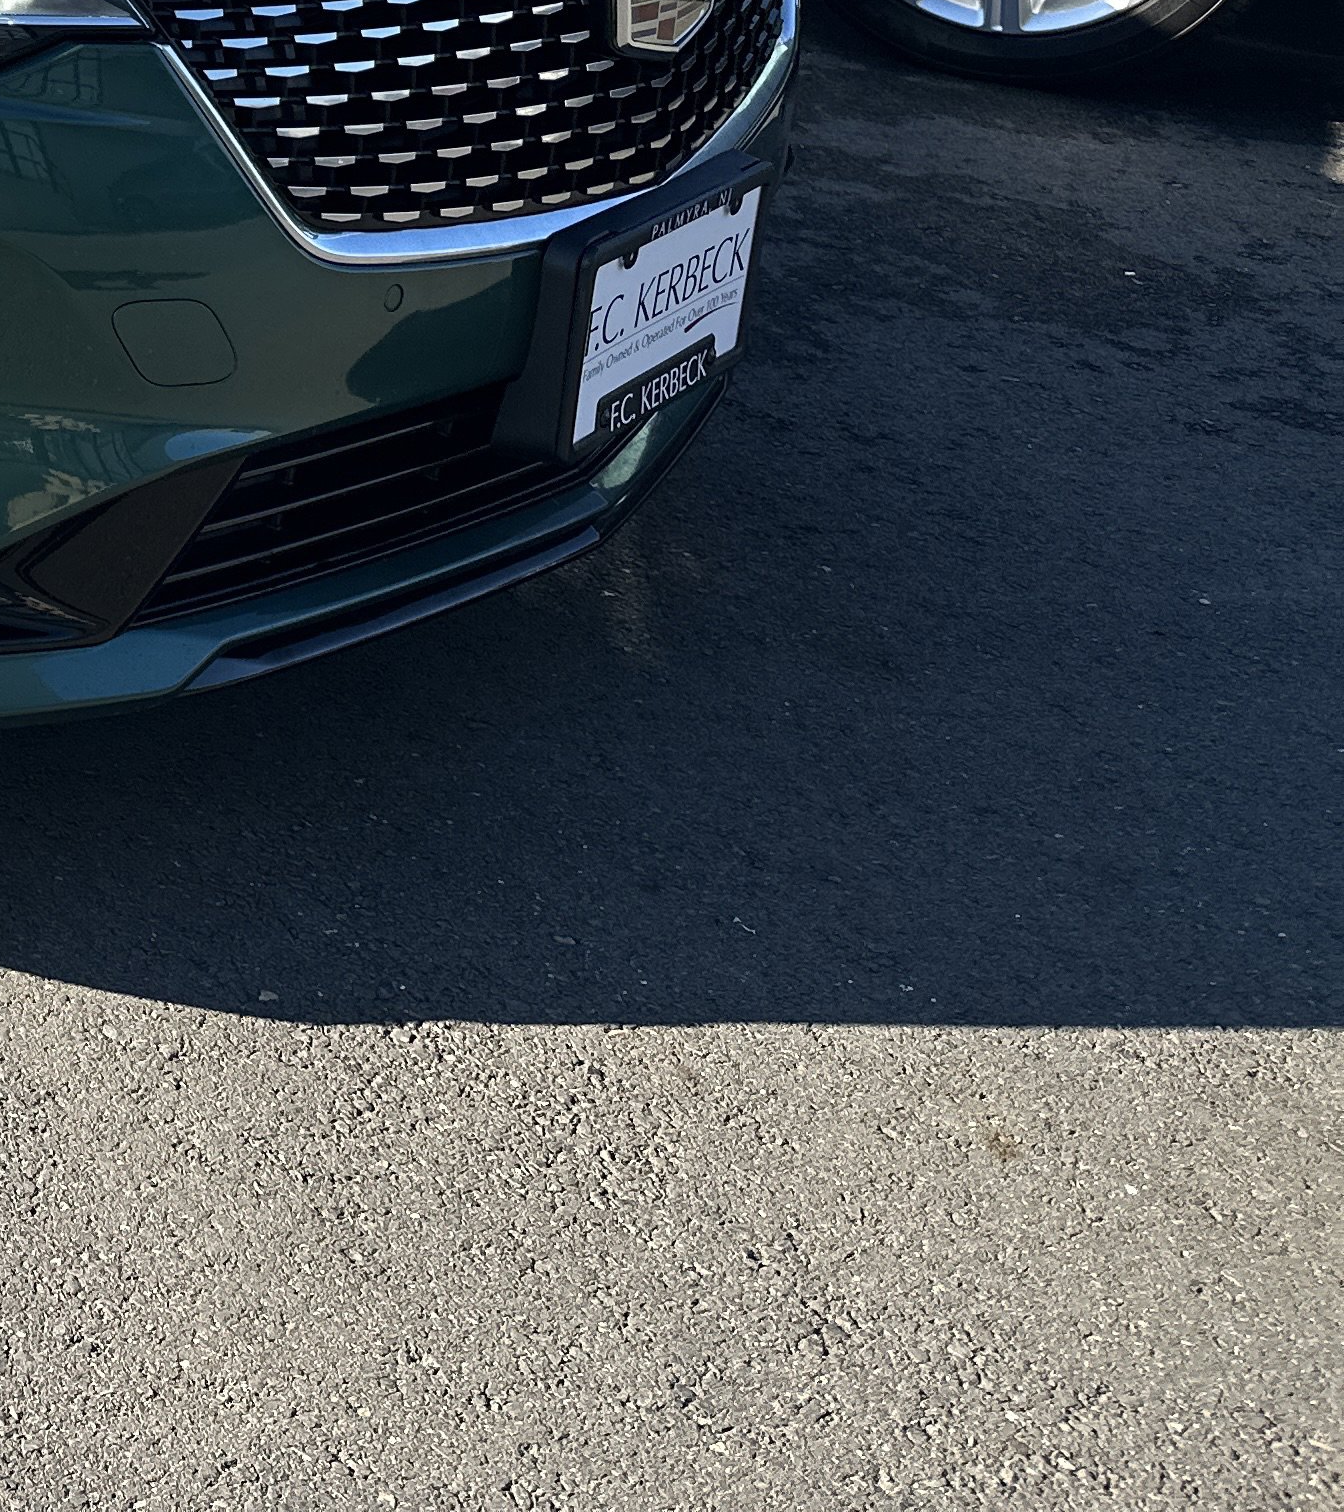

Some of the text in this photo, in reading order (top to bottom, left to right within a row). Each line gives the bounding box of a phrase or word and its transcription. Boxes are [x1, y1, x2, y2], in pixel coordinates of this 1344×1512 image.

[584, 227, 751, 357] F.C. KERBECK
[605, 345, 633, 370] Owned
[641, 318, 675, 350] Operated
[675, 314, 688, 334] For
[687, 303, 705, 328] Over
[609, 348, 710, 432] F.C. KERBECK
